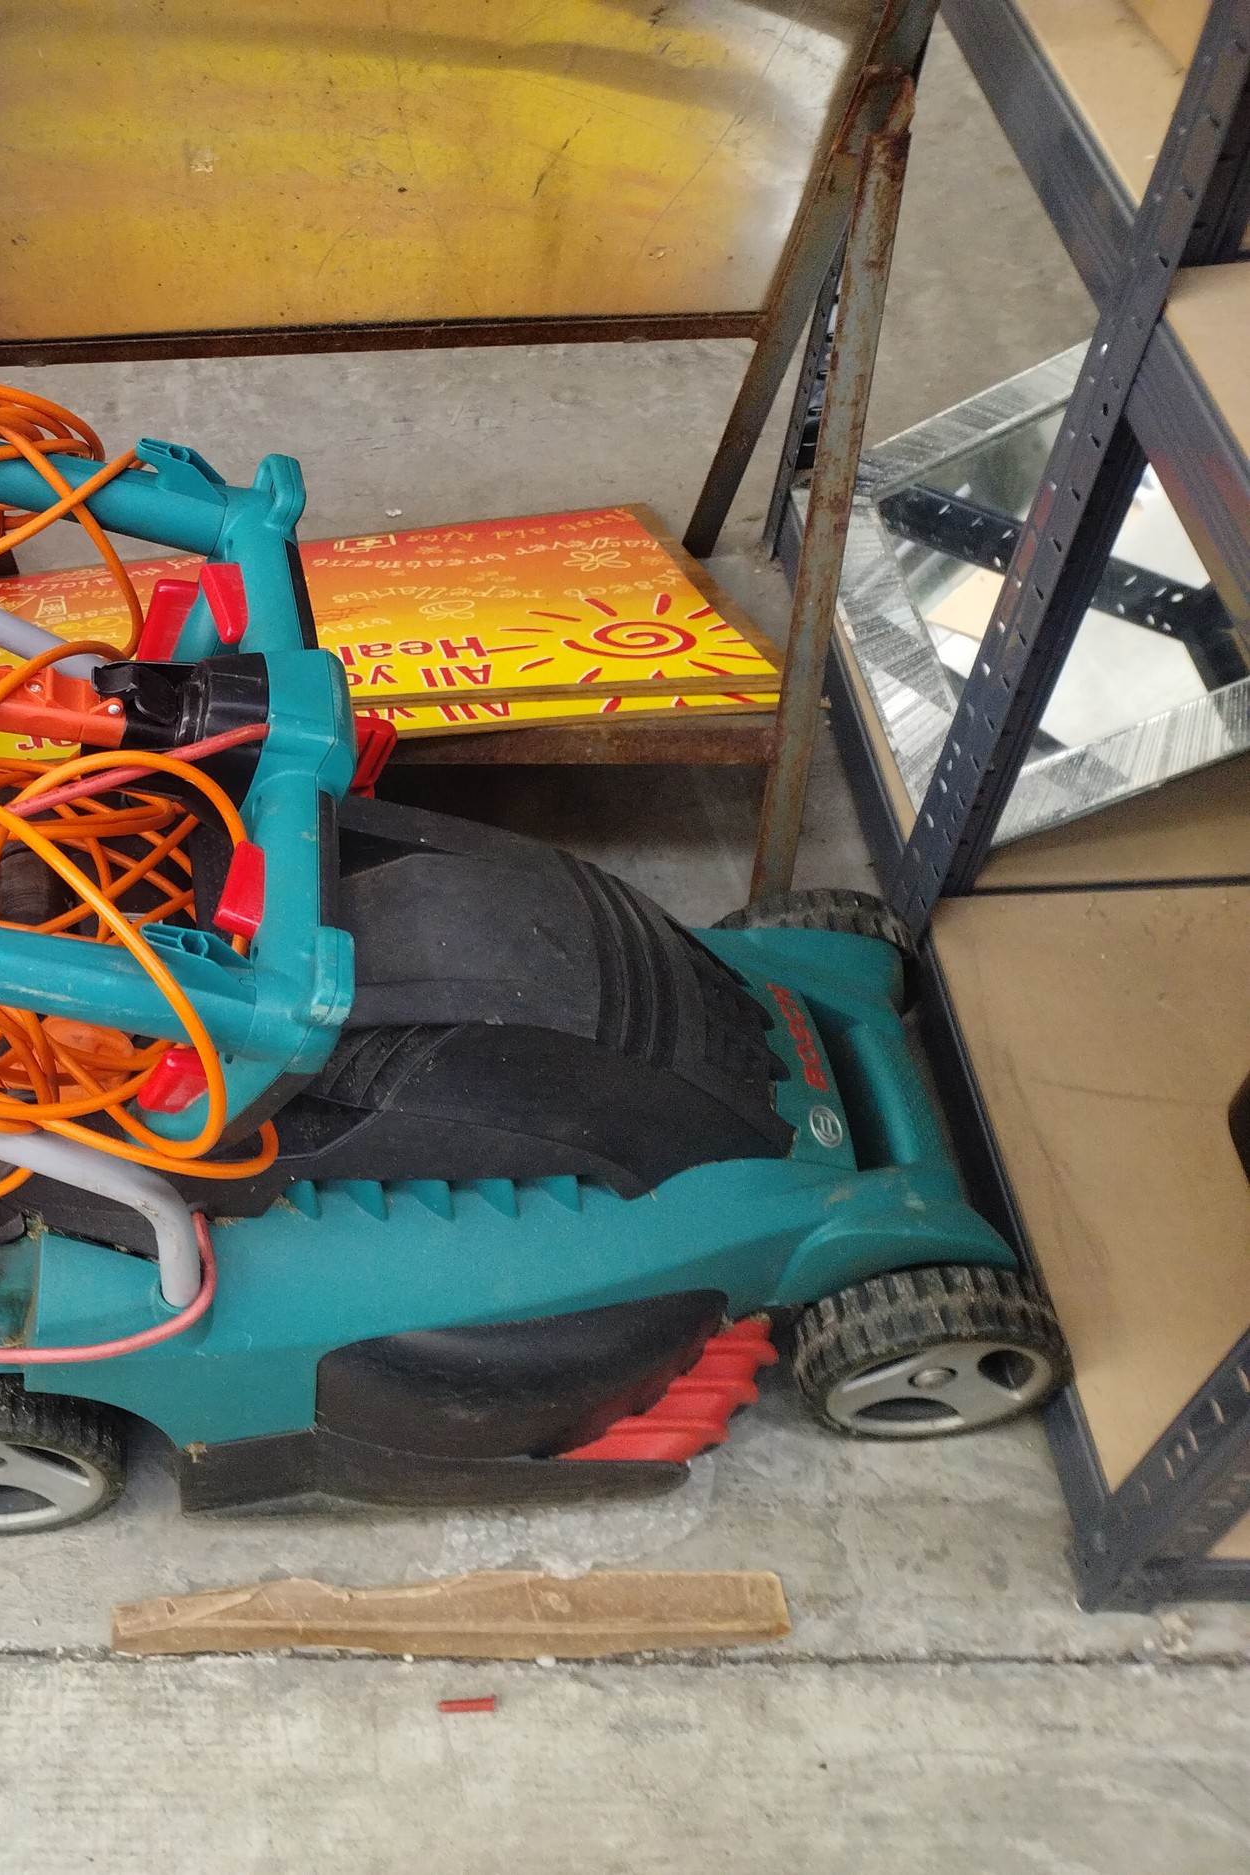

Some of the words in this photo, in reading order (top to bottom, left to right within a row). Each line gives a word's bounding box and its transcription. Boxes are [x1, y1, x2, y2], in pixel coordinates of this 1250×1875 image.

[338, 636, 487, 666] Heal
[420, 664, 492, 688] All
[766, 982, 830, 1092] BOSCH
